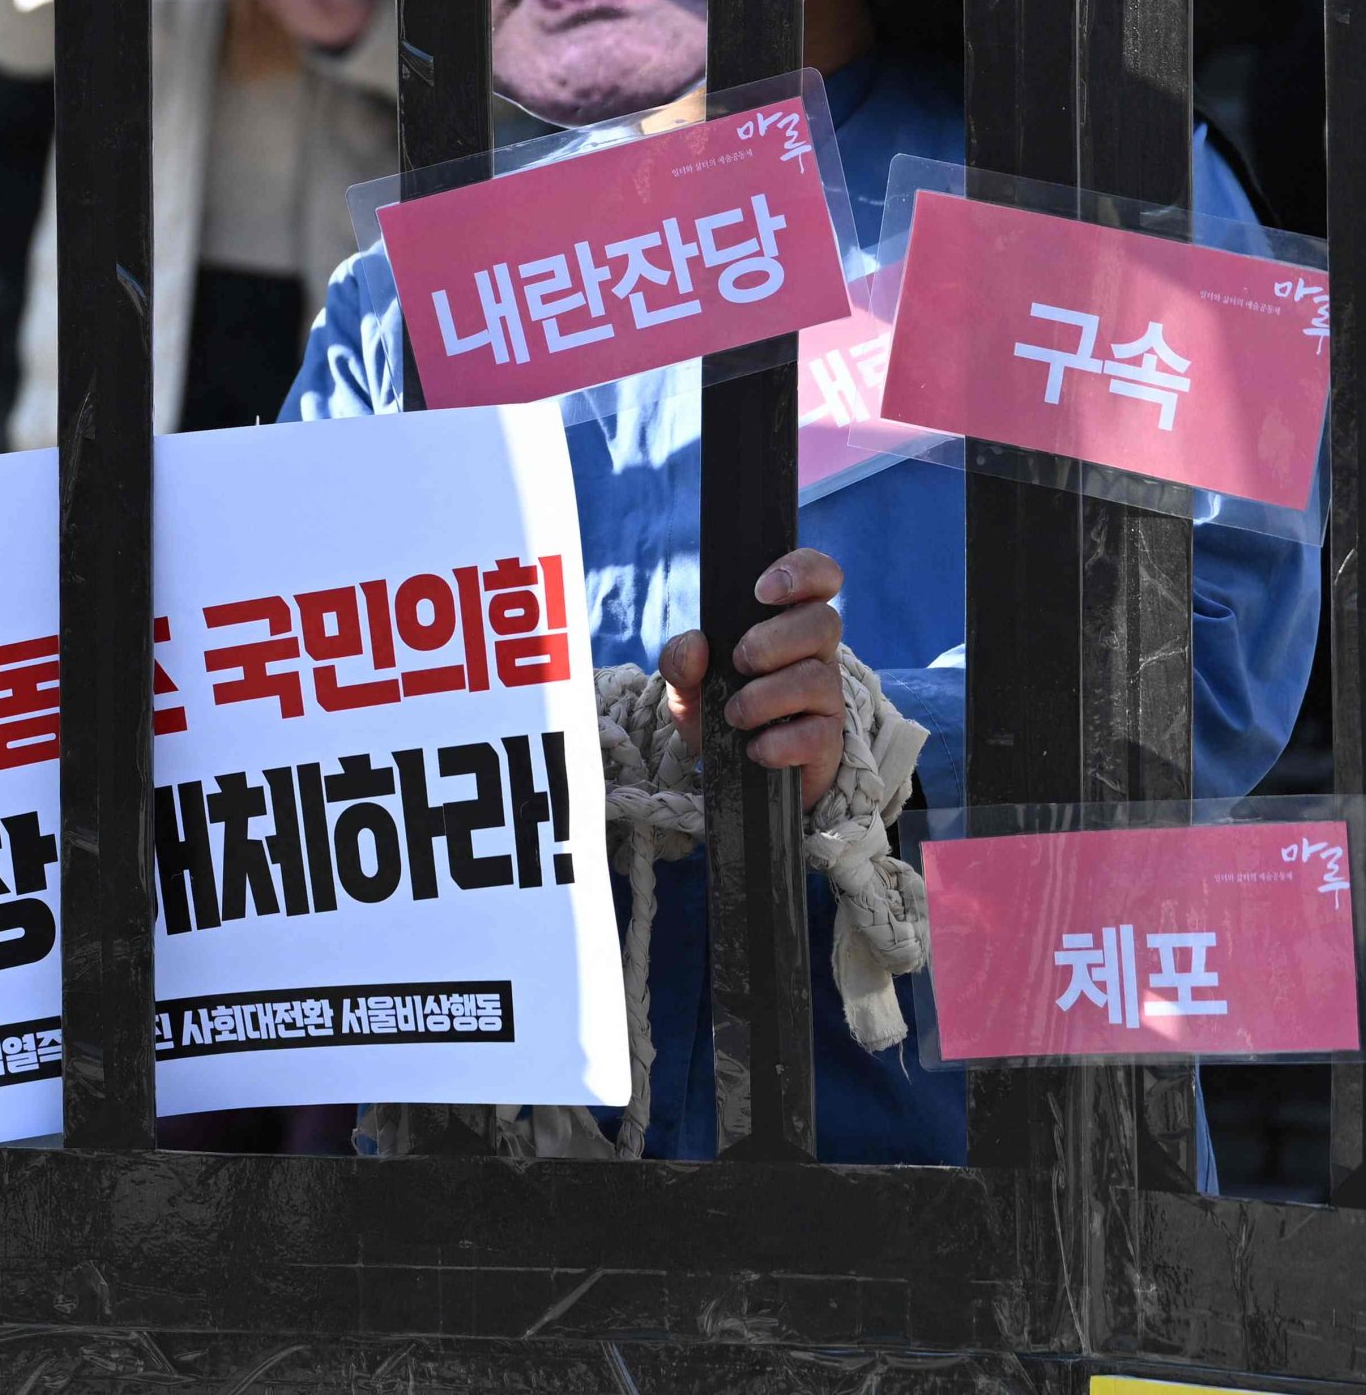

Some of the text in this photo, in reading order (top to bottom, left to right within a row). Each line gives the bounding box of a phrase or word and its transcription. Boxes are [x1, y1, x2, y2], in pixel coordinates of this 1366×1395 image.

[431, 192, 787, 365] 내란잔당
[1013, 302, 1192, 432] 구속
[203, 553, 572, 720] 국민의힘
[181, 998, 335, 1046] 사회대전환
[341, 993, 503, 1035] 서울비상행동
[1053, 923, 1228, 1030] 체포
